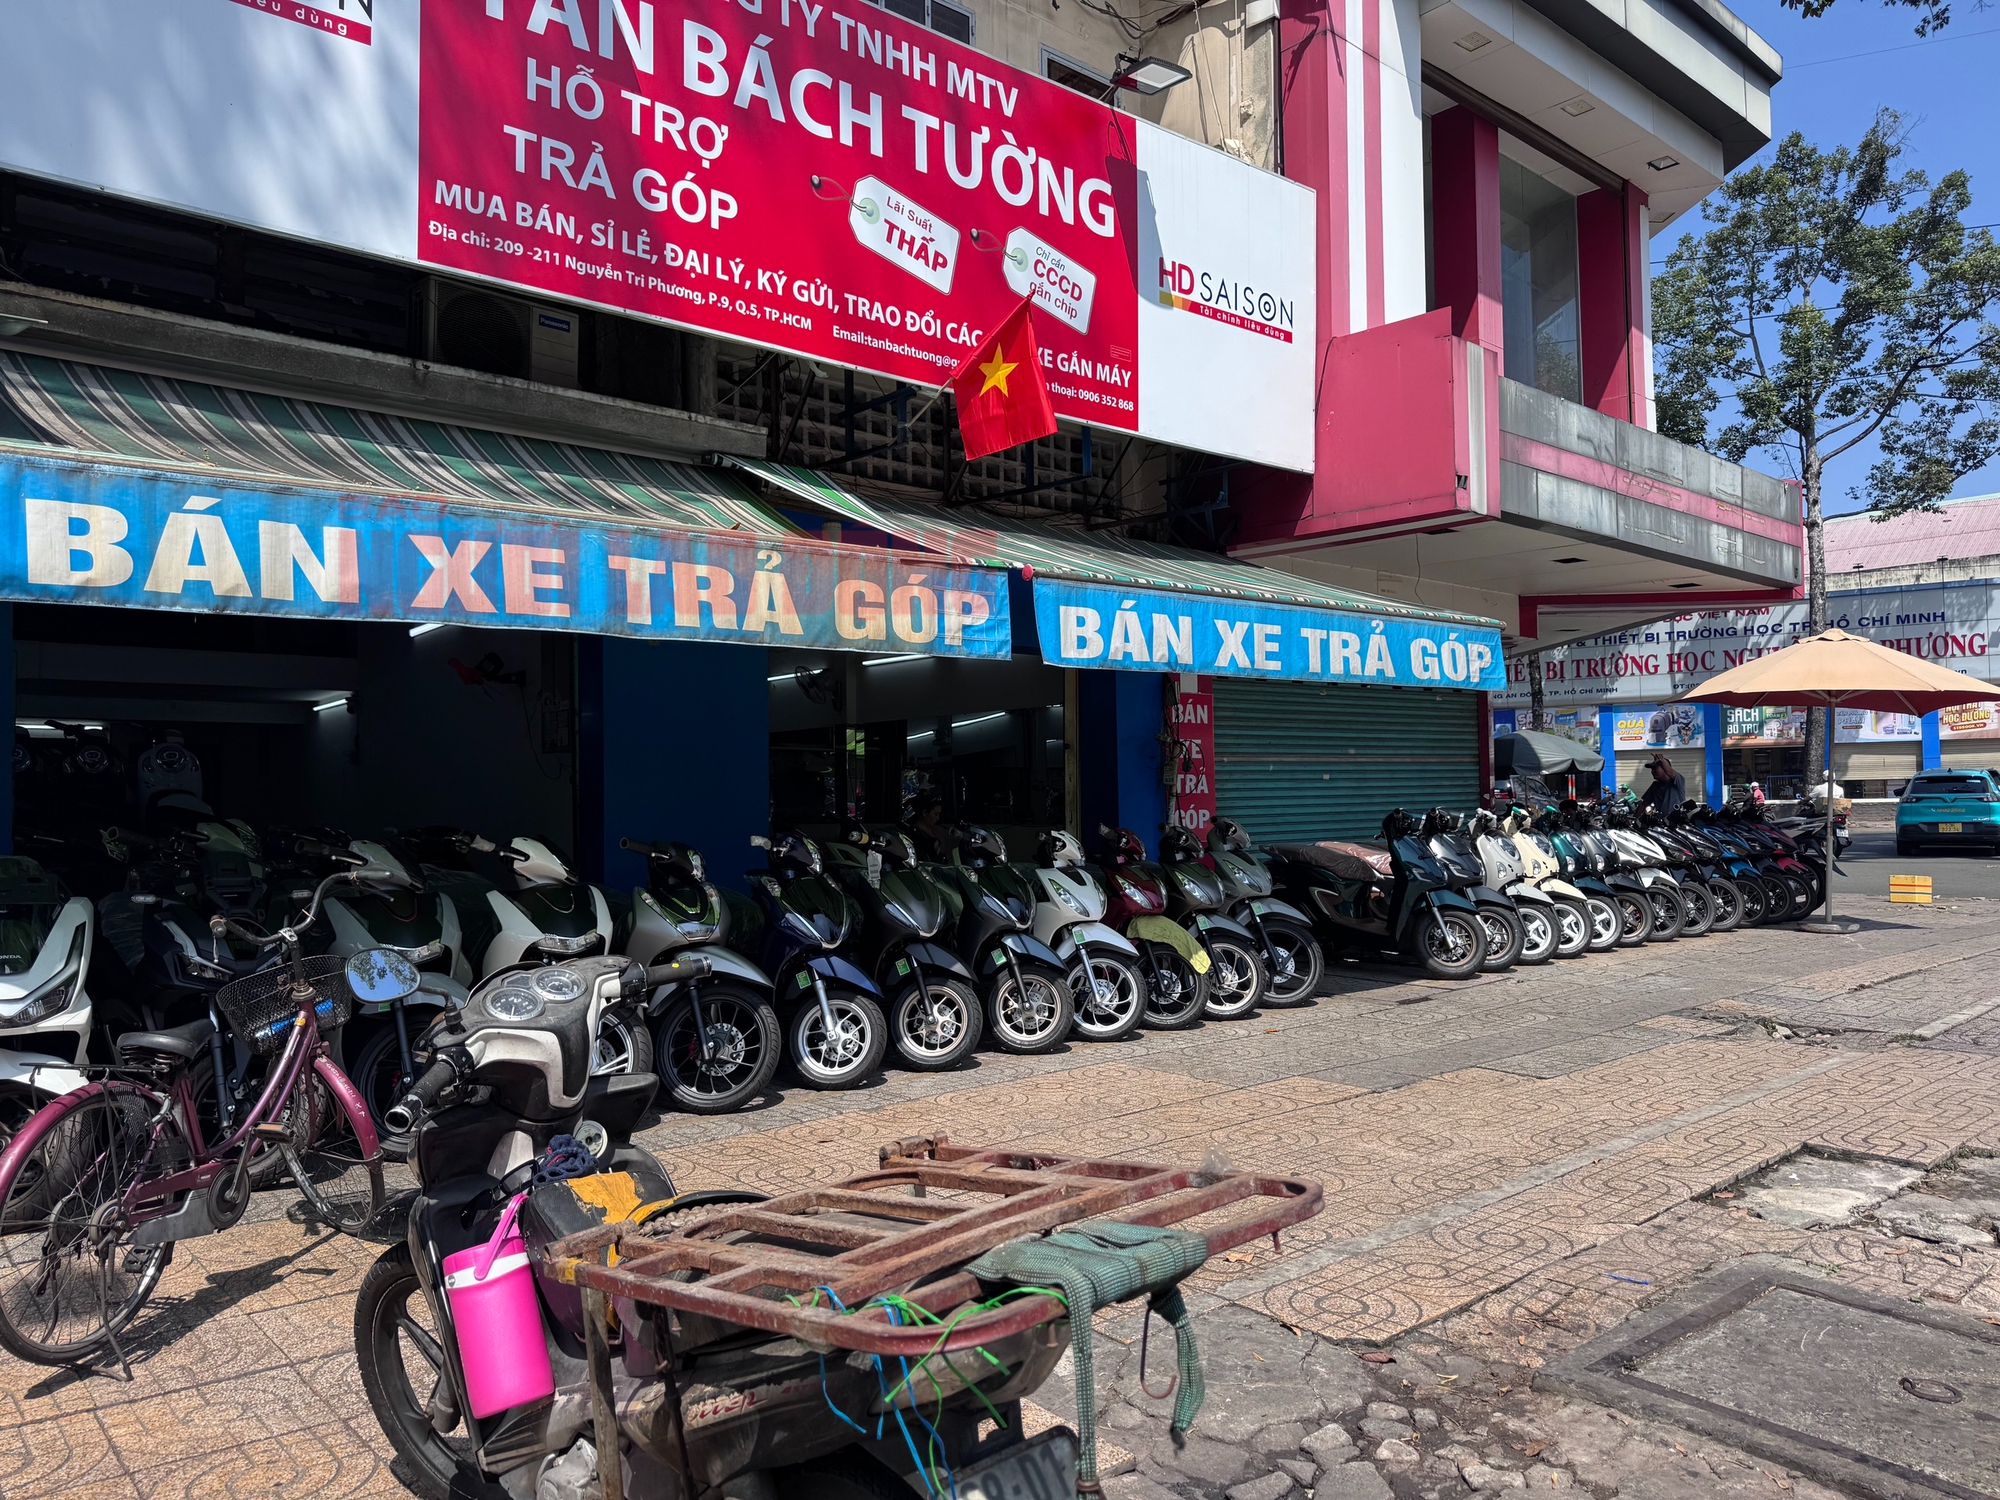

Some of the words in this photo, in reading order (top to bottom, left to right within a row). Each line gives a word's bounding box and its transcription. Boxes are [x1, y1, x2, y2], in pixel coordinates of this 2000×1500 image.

[295, 8, 348, 36] dùng
[832, 11, 936, 88] TNHH
[947, 60, 1019, 118] MTV
[527, 57, 604, 120] HỖ
[621, 89, 729, 169] TRỢ
[683, 18, 884, 158] BÁCH
[901, 104, 1116, 238] TƯỜNG
[503, 125, 617, 200] TRẢ
[632, 171, 739, 230] GÓP
[886, 196, 904, 217] Lãi
[907, 209, 933, 234] Suất
[883, 218, 948, 272] THẤP
[435, 179, 507, 222] MUA
[516, 201, 584, 244] BÁN,
[591, 219, 615, 250] SỈ
[622, 228, 658, 265] LẺ,
[664, 243, 708, 279] ĐẠI
[716, 257, 752, 290] LÝ,
[757, 268, 788, 296] KÝ
[793, 278, 839, 315] GỬI,
[844, 292, 901, 327] TRAO
[905, 309, 941, 339] ĐỔI
[1057, 350, 1092, 379] GẮN
[1096, 364, 1132, 388] MÁY
[1033, 259, 1083, 302] CCCD
[1159, 257, 1195, 296] HD
[1200, 272, 1293, 329] SAISON
[428, 220, 458, 242] Địa
[461, 230, 491, 249] chỉ:
[494, 237, 524, 256] 209
[526, 247, 560, 266] -211
[565, 256, 623, 282] Nguyễn
[625, 270, 645, 288] Tri
[648, 276, 706, 305] Phương,
[708, 291, 733, 312] P.9,
[735, 299, 761, 319] Q.5,
[763, 306, 812, 331] TP.HCM
[1051, 382, 1077, 399] thoại:
[1078, 388, 1100, 403] 0906
[1101, 394, 1117, 408] 352
[1118, 399, 1134, 411] 868
[540, 317, 569, 330] Panasonic
[1054, 297, 1078, 320] chip
[1217, 311, 1241, 326] chính
[1264, 326, 1285, 341] dùng
[25, 495, 360, 604] BÁN
[408, 534, 571, 618] XE
[608, 549, 804, 635] TRẢ
[834, 573, 990, 646] GÓP
[1645, 632, 1660, 645] BỊ
[1665, 625, 1738, 641] TRƯỜNG
[1743, 623, 1783, 637] HỌC
[1826, 613, 1850, 629] HỒ
[1858, 612, 1891, 627] CHÍ
[1896, 611, 1945, 625] MINH
[1735, 607, 1769, 617] NAM
[1059, 599, 1194, 665] BÁN
[1213, 619, 1282, 671] XE
[1300, 619, 1396, 678] TRẢ
[1410, 632, 1492, 683] GÓP
[1545, 660, 1566, 683] BỊ
[1571, 650, 1660, 679] TRƯỜNG
[1667, 650, 1716, 676] HỌC
[1172, 699, 1208, 724] BÁN
[1943, 713, 1960, 724] HỌC
[1175, 767, 1209, 794] TRẢ
[1174, 804, 1210, 829] GÓP
